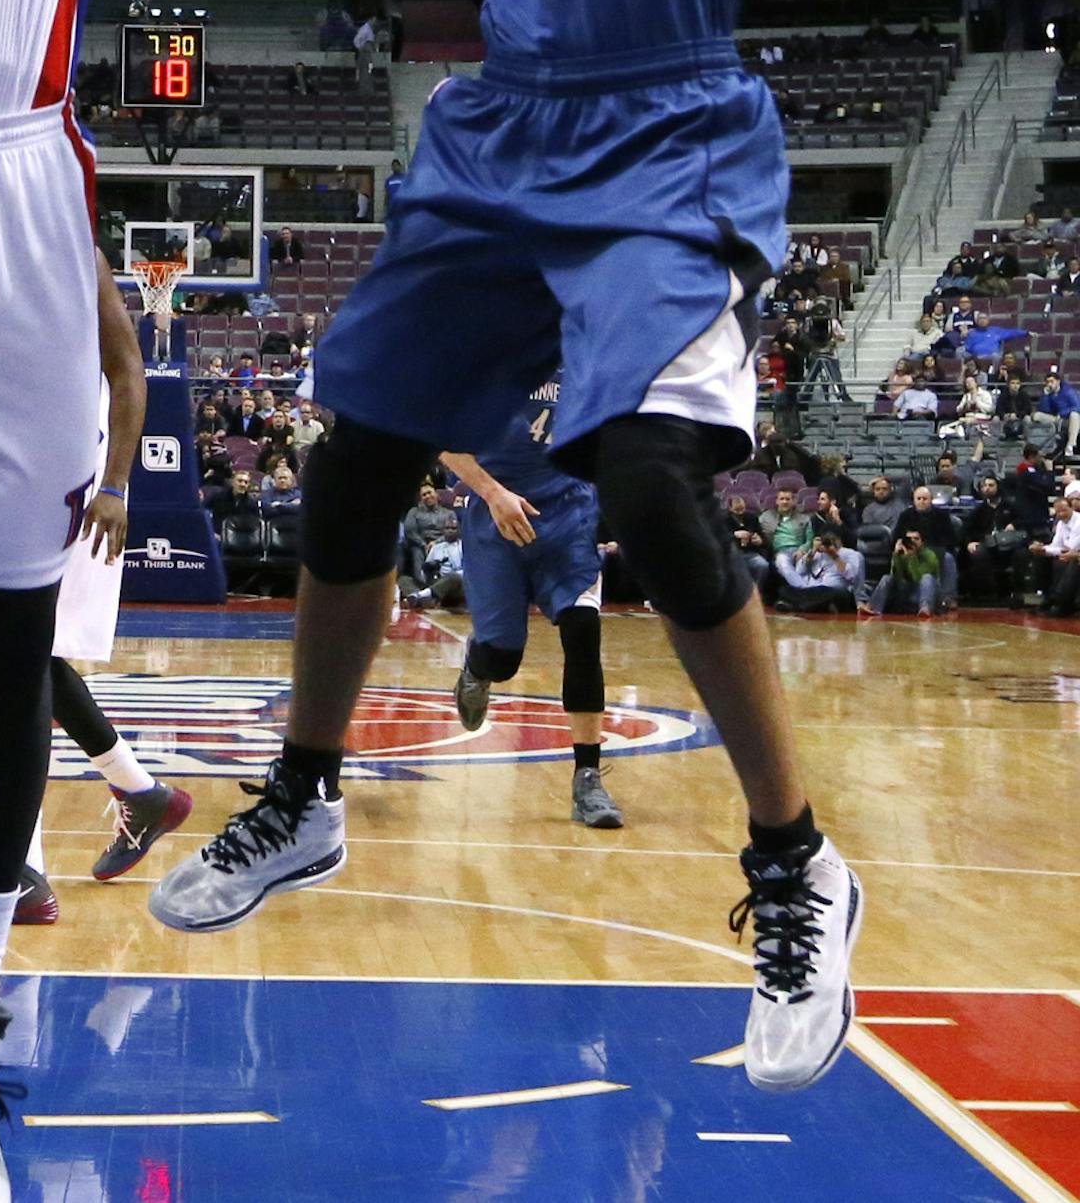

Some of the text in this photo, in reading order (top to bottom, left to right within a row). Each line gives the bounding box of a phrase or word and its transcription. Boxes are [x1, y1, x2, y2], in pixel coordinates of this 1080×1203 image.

[154, 60, 189, 98] 18
[144, 368, 181, 379] SPALDING
[143, 559, 175, 569] THIRD
[176, 560, 206, 569] BANK
